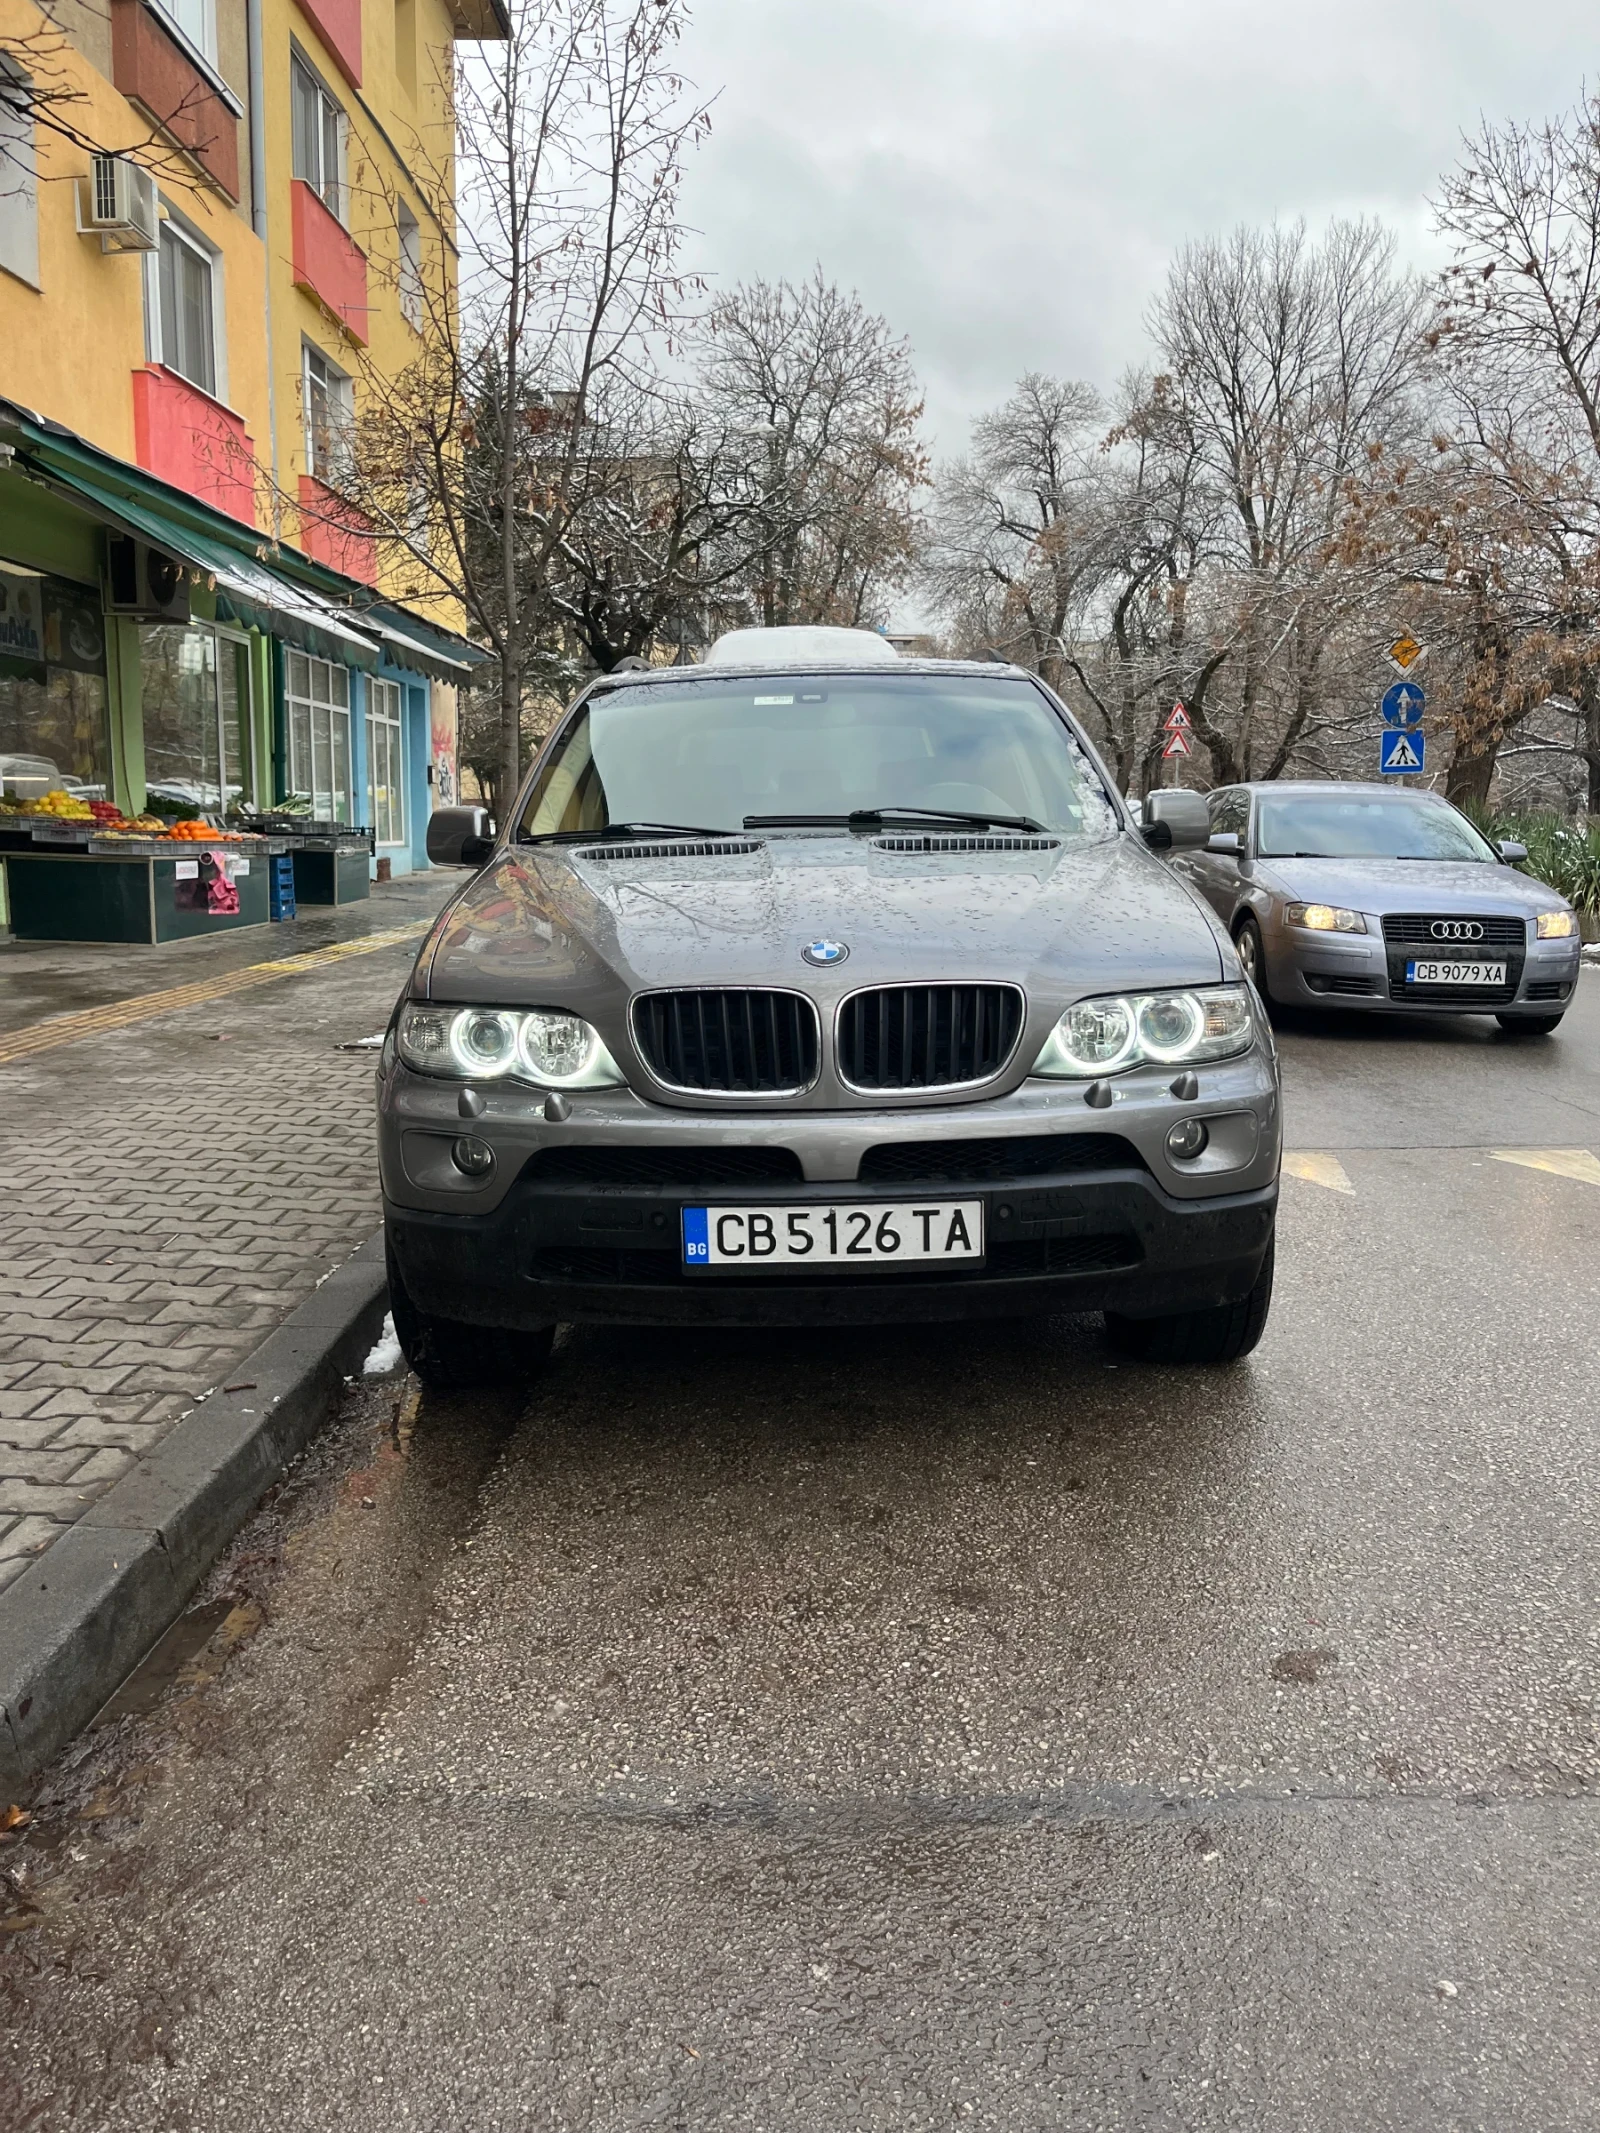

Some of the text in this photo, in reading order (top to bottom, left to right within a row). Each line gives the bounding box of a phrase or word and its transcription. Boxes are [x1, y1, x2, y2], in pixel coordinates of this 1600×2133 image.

[1417, 964, 1503, 982] CB 9079 XA
[716, 1208, 973, 1256] CB 5126 TA
[687, 1242, 707, 1256] BG
